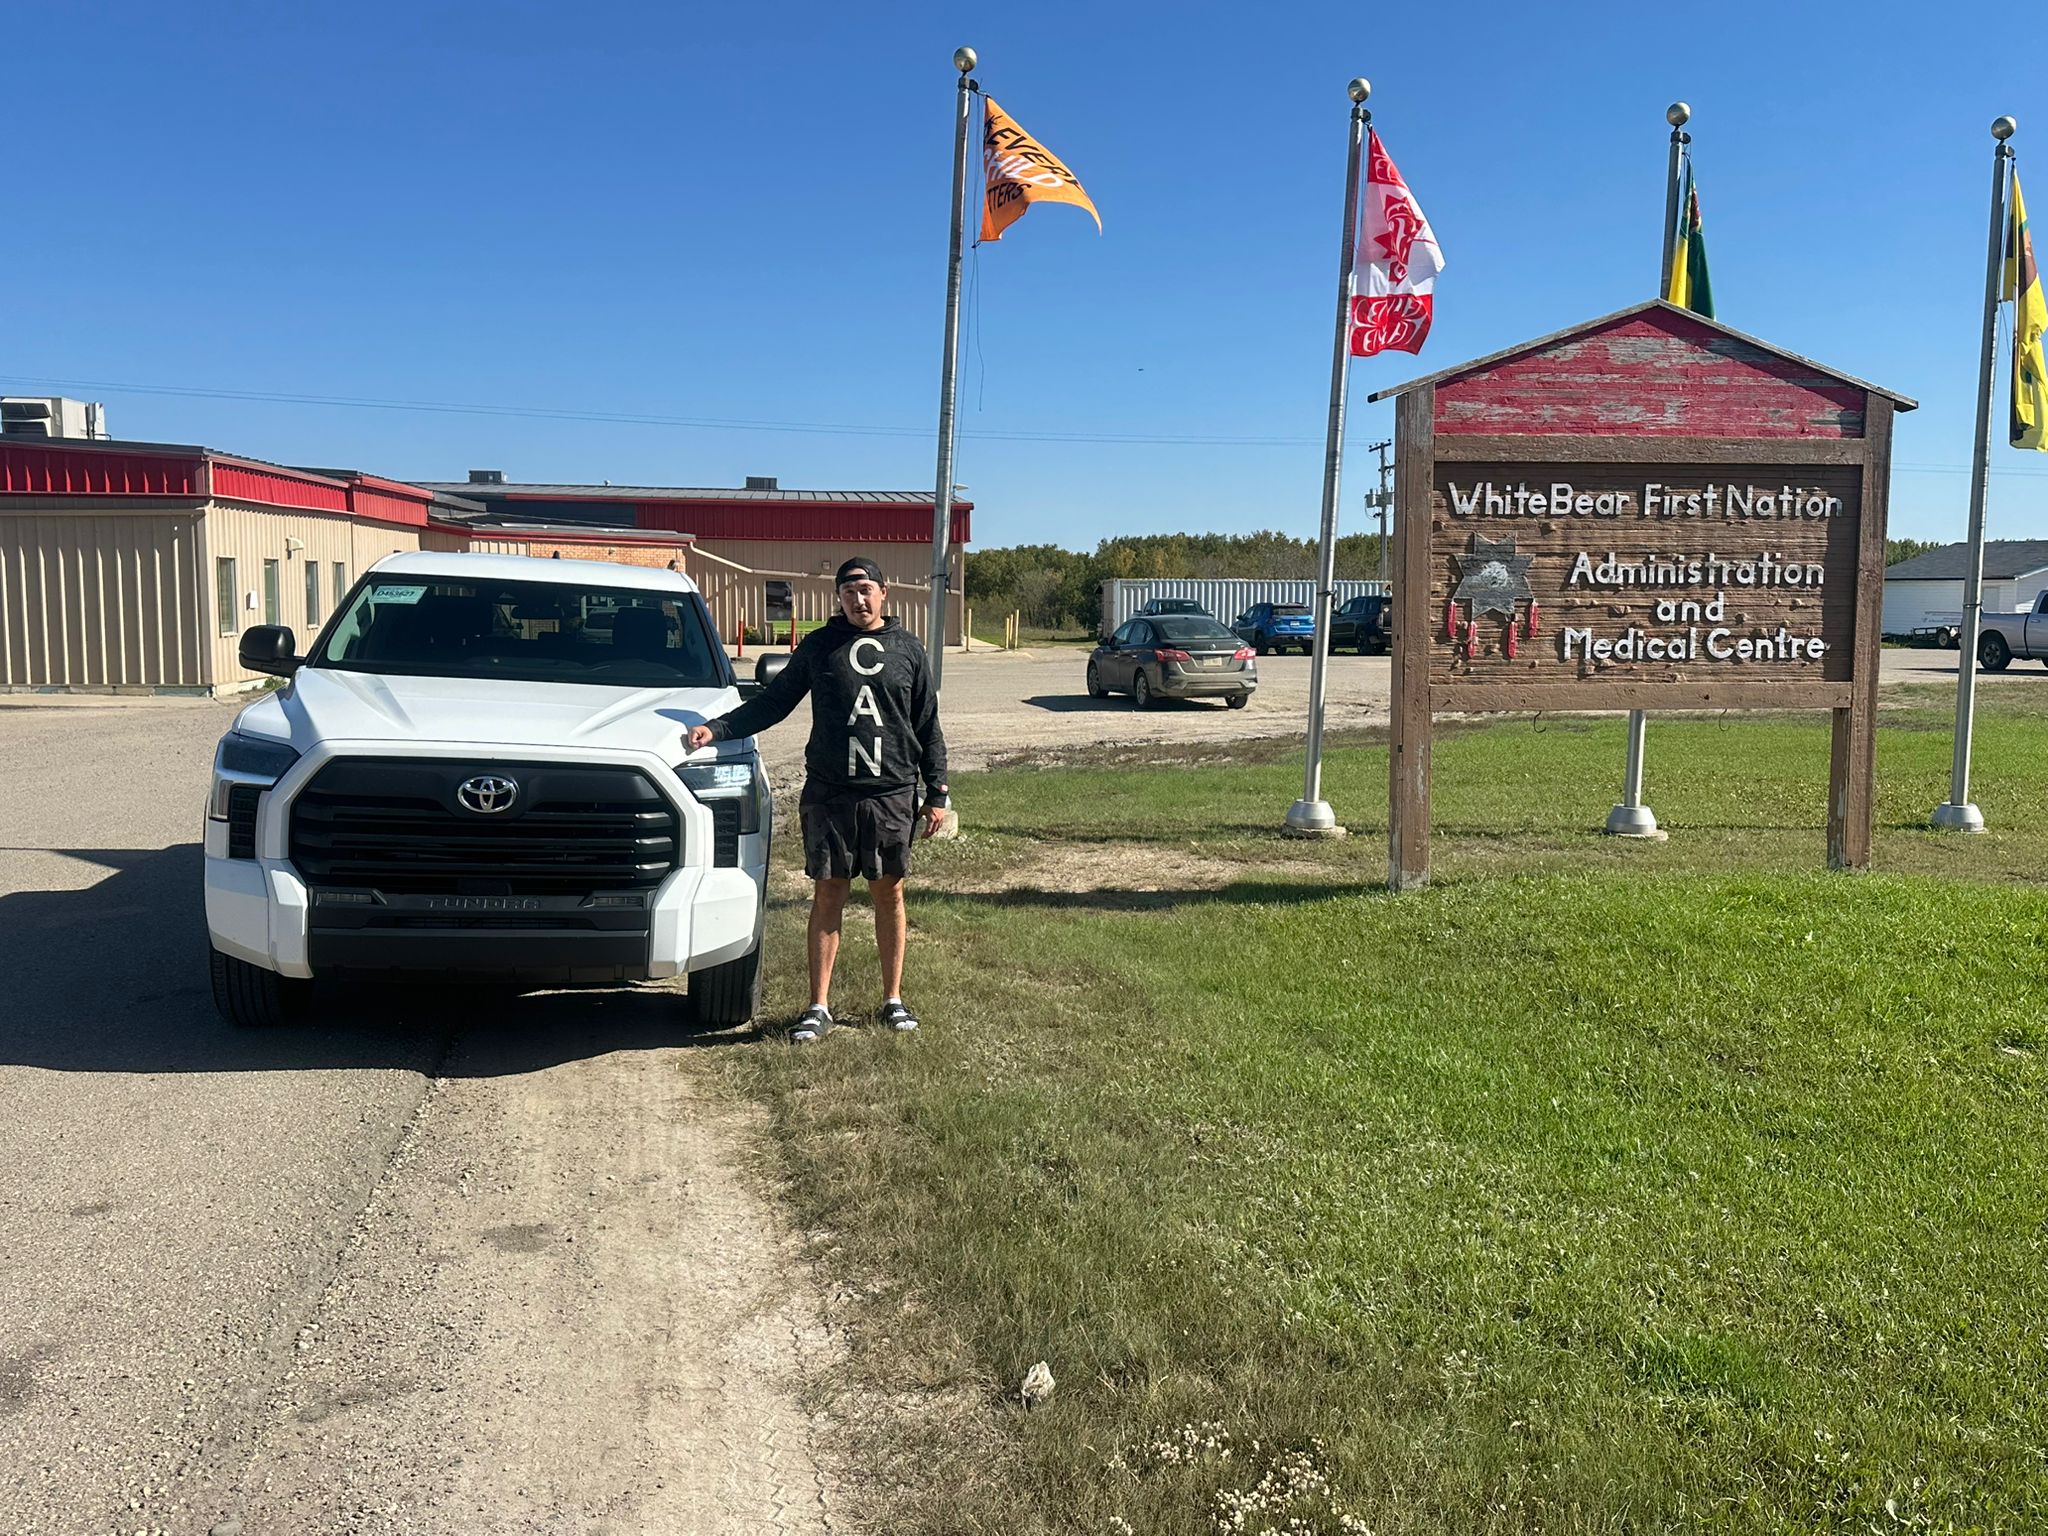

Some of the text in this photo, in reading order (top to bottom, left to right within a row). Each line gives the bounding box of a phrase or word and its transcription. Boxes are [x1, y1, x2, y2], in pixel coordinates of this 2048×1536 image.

[987, 181, 1032, 213] TTERS
[1448, 481, 1843, 518] WhiteBear First Nation
[1569, 551, 1825, 586] Administration
[1656, 592, 1725, 622] and
[1563, 627, 1826, 661] Medical Centre
[847, 637, 884, 777] CAN
[425, 897, 541, 910] TUNDRA
